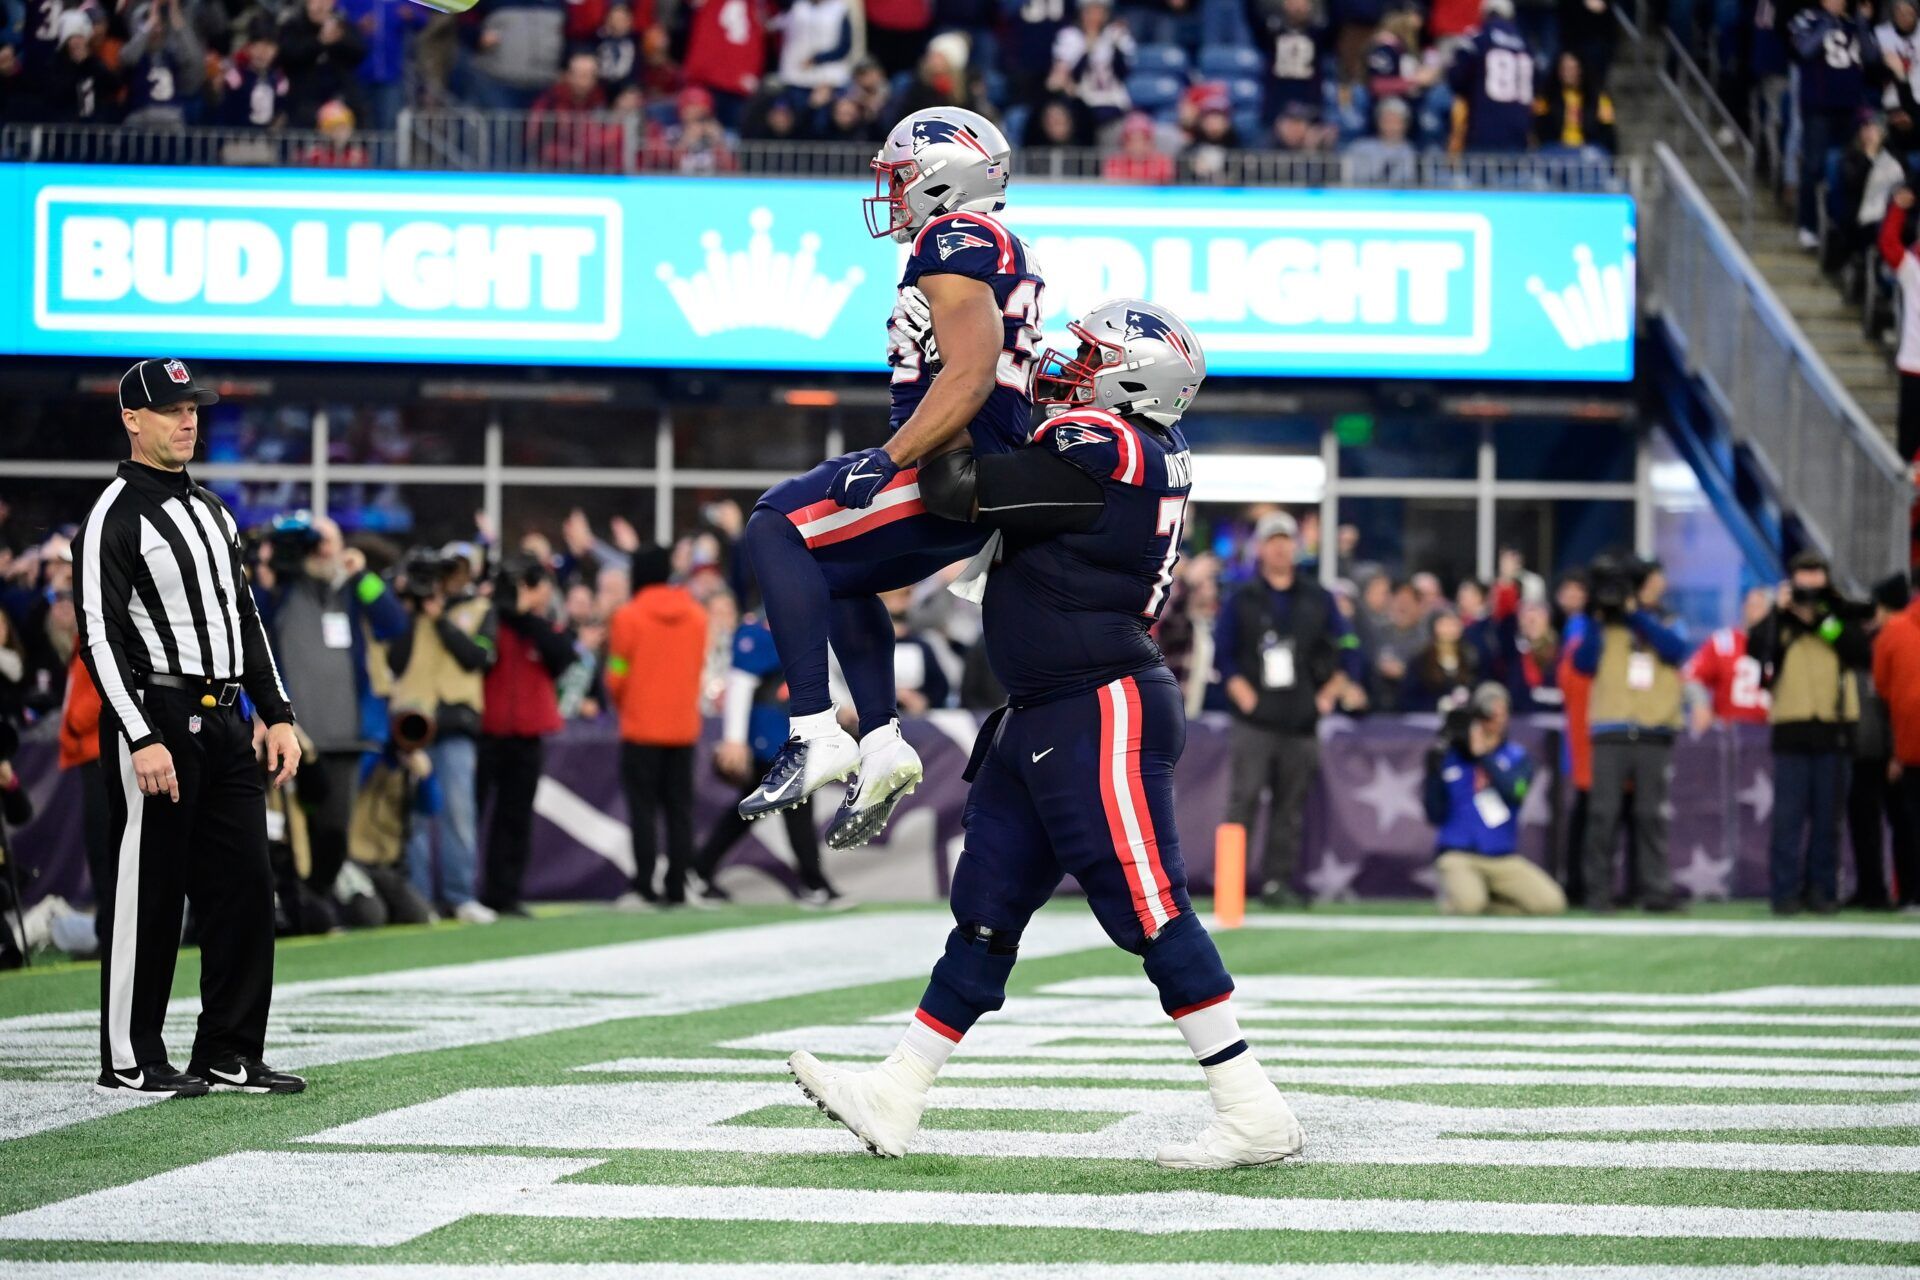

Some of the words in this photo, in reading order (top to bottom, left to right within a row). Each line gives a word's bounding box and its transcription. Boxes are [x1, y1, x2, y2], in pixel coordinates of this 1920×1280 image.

[61, 215, 284, 304] BUD
[291, 219, 597, 312] LIGHT
[1151, 238, 1466, 326] LIGHT
